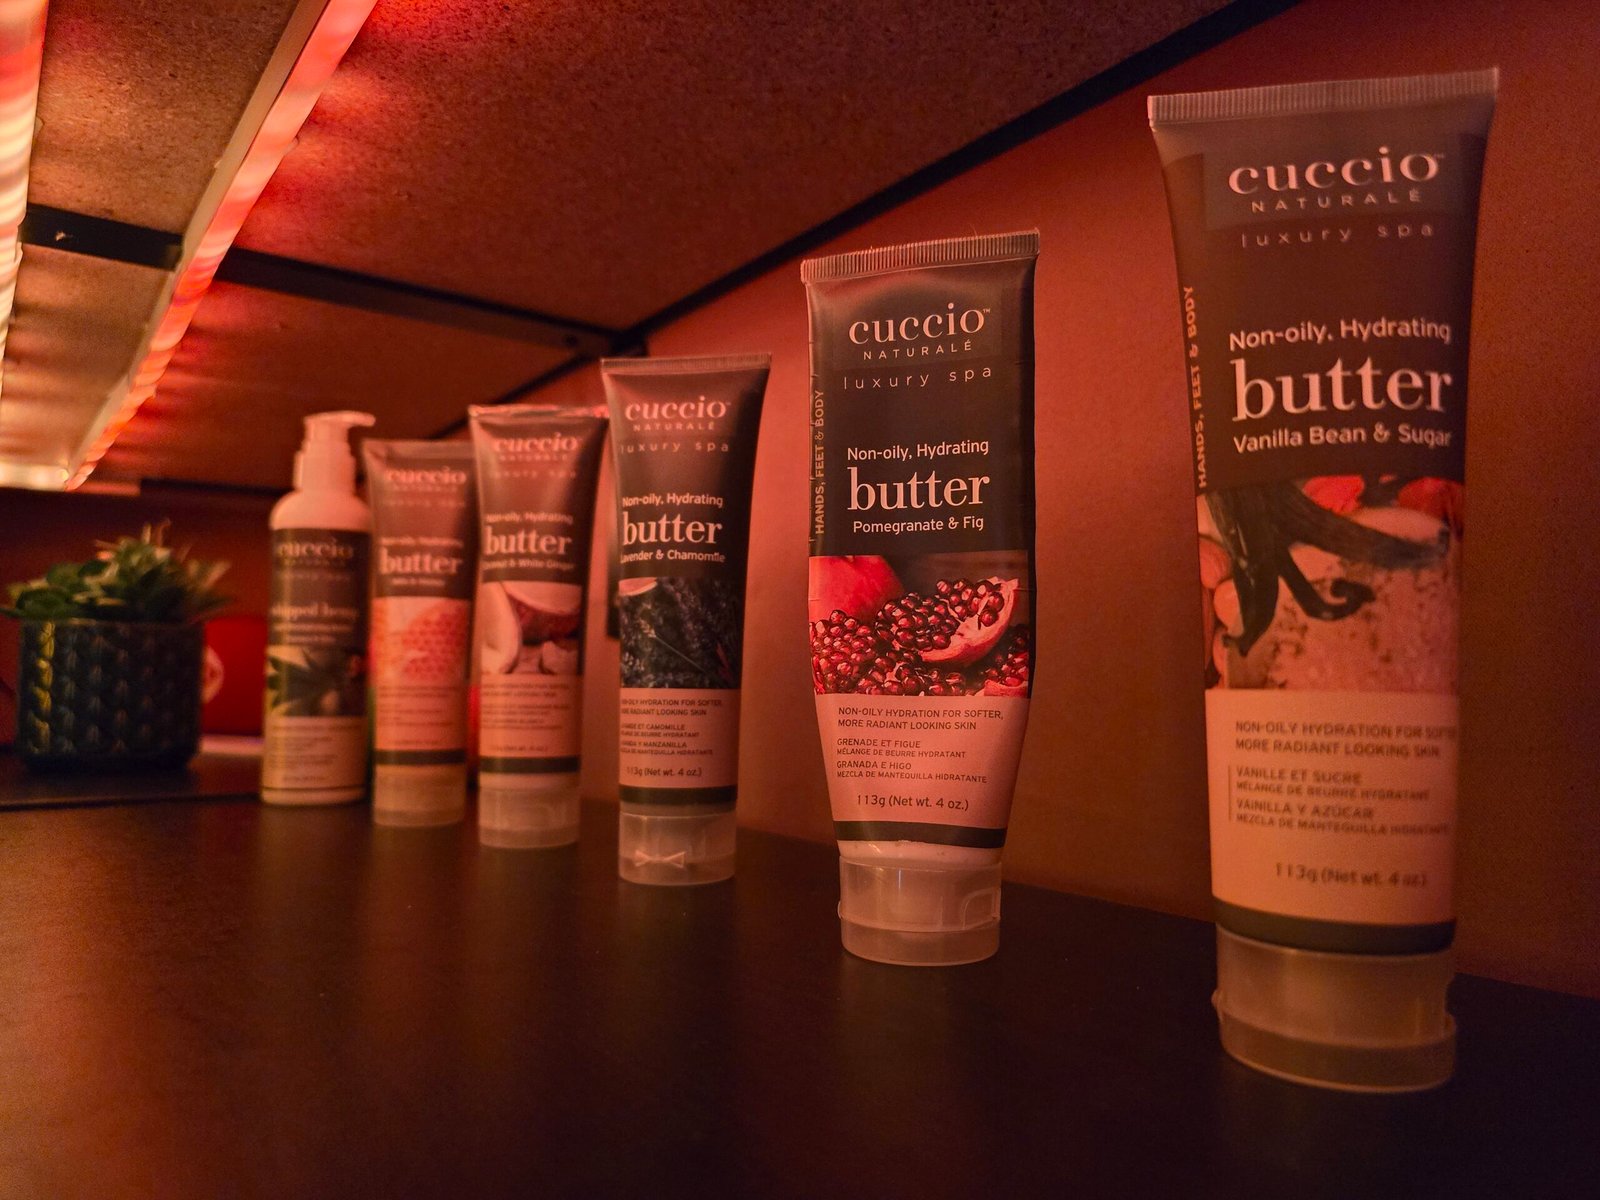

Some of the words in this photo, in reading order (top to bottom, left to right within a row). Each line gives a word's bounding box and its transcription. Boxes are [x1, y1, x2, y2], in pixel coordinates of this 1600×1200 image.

[1252, 188, 1422, 213] NATURALÉ
[1241, 228, 1351, 248] luxury
[1377, 222, 1434, 239] spa
[1183, 286, 1197, 338] BODY
[1340, 317, 1452, 345] Hydrating
[863, 339, 972, 360] NATURALÉ
[843, 374, 930, 390] luxury
[949, 367, 992, 383] spa
[1191, 365, 1202, 410] FEET
[1230, 356, 1453, 422] butter
[815, 390, 824, 427] BODY
[815, 431, 824, 440] &
[1233, 428, 1302, 454] Vanilla
[1310, 425, 1366, 445] Bean
[1373, 422, 1391, 443] &
[1398, 423, 1452, 449] Sugar
[621, 442, 681, 454] luxury
[695, 441, 729, 452] spa
[847, 446, 913, 461] Non-oily,
[917, 440, 989, 458] Hydrating
[815, 445, 825, 478] FEET
[847, 467, 990, 511] butter
[667, 492, 724, 508] Hydrating
[622, 511, 723, 546] butter
[853, 517, 943, 535] Pomegranate
[948, 516, 959, 530] &
[963, 516, 984, 531] Fig
[485, 526, 573, 555] butter
[656, 549, 664, 560] &
[667, 549, 726, 563] Chamomile
[838, 707, 884, 717] NON-OILY
[886, 709, 940, 718] HYDRATION
[942, 709, 962, 718] FOR
[964, 709, 1004, 720] SOFTER,
[838, 719, 864, 728] MORE
[866, 720, 908, 730] RADIANT
[910, 721, 951, 730] LOOKING
[954, 721, 977, 731] SKIN
[1235, 721, 1298, 734] NON-OILY
[1302, 723, 1393, 740] HYDRATION
[1395, 726, 1422, 740] FOR
[837, 738, 878, 747] GRENADE
[881, 739, 892, 748] ET
[894, 740, 921, 749] FIGUE
[837, 747, 871, 756] MÉLANGE
[873, 748, 883, 756] DE
[885, 749, 916, 757] BEURRE
[918, 750, 966, 759] HYDRATANT
[1235, 739, 1270, 751] MORE
[1273, 741, 1341, 756] RADIANT
[1344, 743, 1411, 758] LOOKING
[1414, 745, 1440, 759] SKIN
[678, 768, 684, 777] 4
[836, 760, 878, 769] GRANADA
[880, 761, 887, 769] E
[889, 762, 912, 770] HIGO
[837, 770, 864, 778] MEZCLA
[866, 770, 876, 778] DE
[878, 771, 933, 780] MANTEQUILLA
[935, 773, 987, 784] HIDRATANTE
[1236, 766, 1286, 780] VANILLE
[1290, 769, 1308, 782] ET
[1312, 770, 1362, 785] SUCRE
[1287, 784, 1303, 795] DE
[857, 794, 886, 808] 113g
[888, 795, 913, 808] (Net
[915, 797, 932, 808] wt.
[936, 798, 944, 809] 4
[947, 799, 969, 812] oz.)
[1297, 804, 1309, 816] Y
[1279, 817, 1295, 829] DE
[1321, 865, 1358, 885] (Net
[1388, 869, 1399, 885] 4
